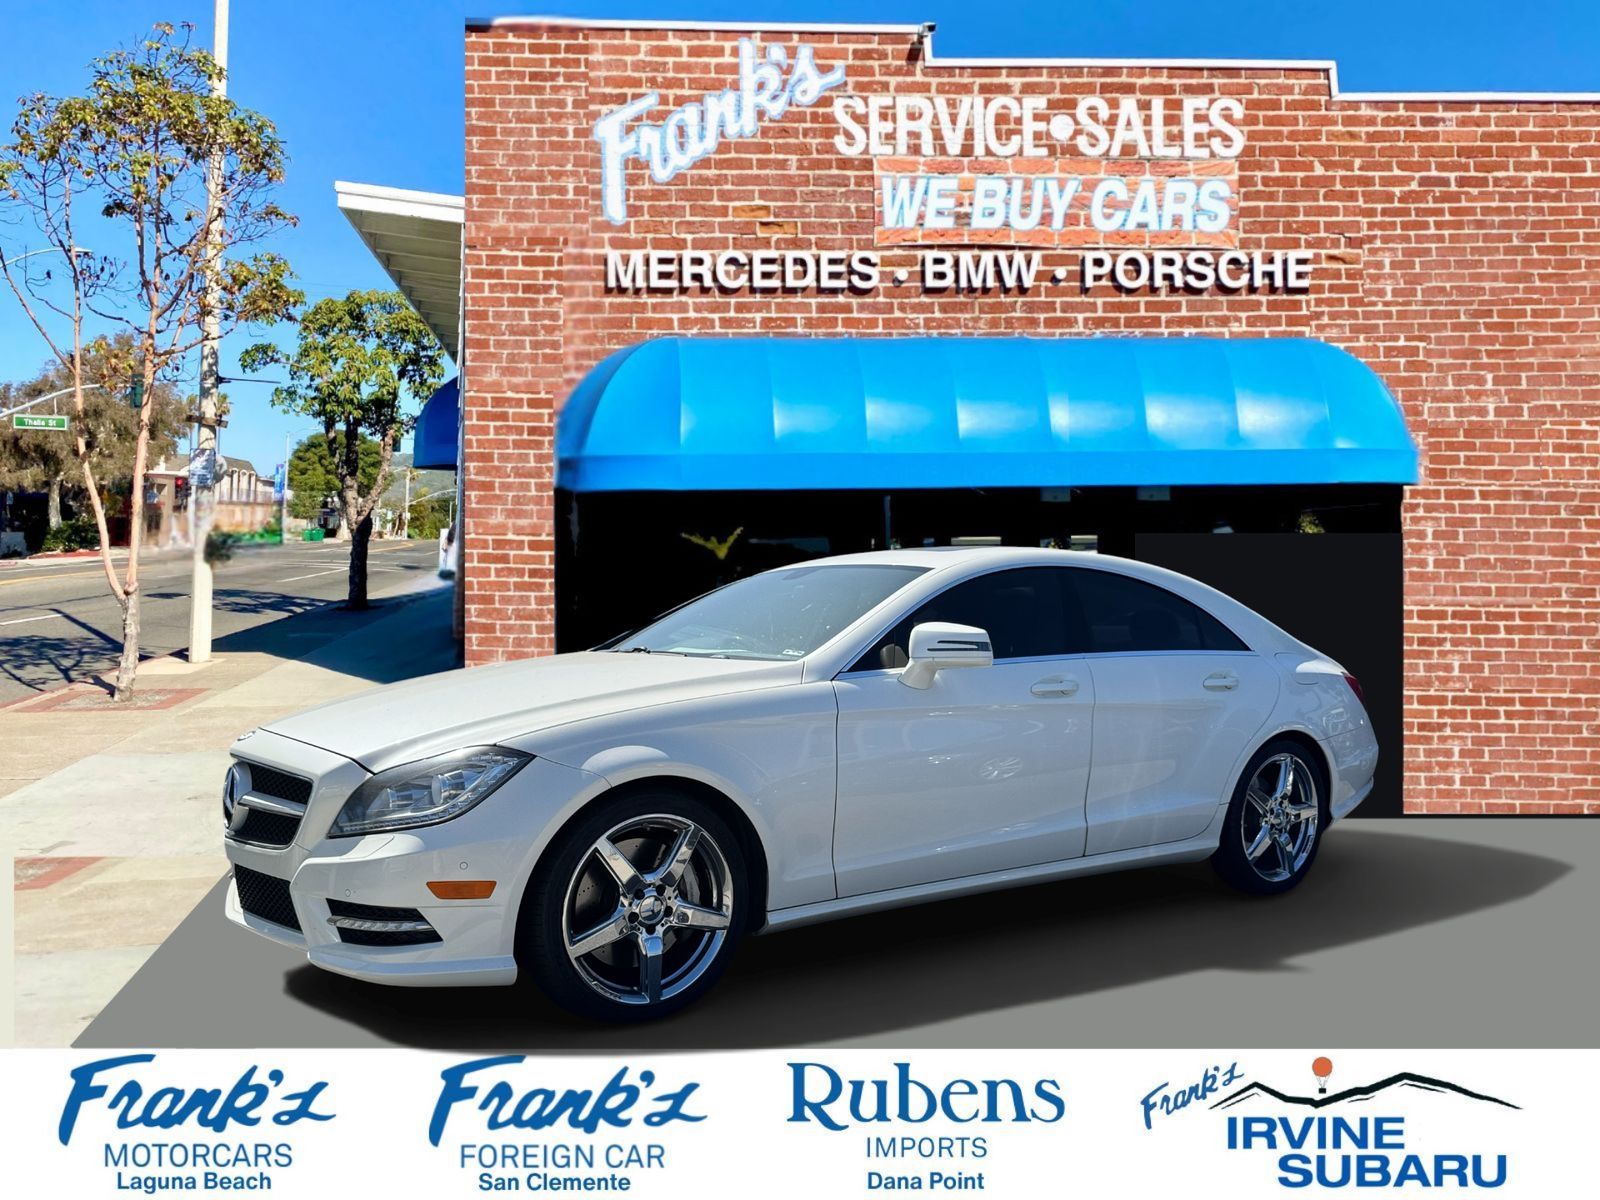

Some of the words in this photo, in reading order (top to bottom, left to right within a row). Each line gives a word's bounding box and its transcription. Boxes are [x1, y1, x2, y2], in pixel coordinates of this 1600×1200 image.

[594, 38, 847, 226] Frank's
[833, 97, 1048, 157] SERVICE
[1075, 97, 1246, 157] SALES
[881, 175, 957, 231] WE
[970, 176, 1081, 231] BUY
[1089, 178, 1233, 233] CARS
[605, 249, 881, 292] MERCEDES
[922, 250, 1042, 292] BMW
[1081, 250, 1313, 291] PORSCHE
[48, 419, 57, 427] St
